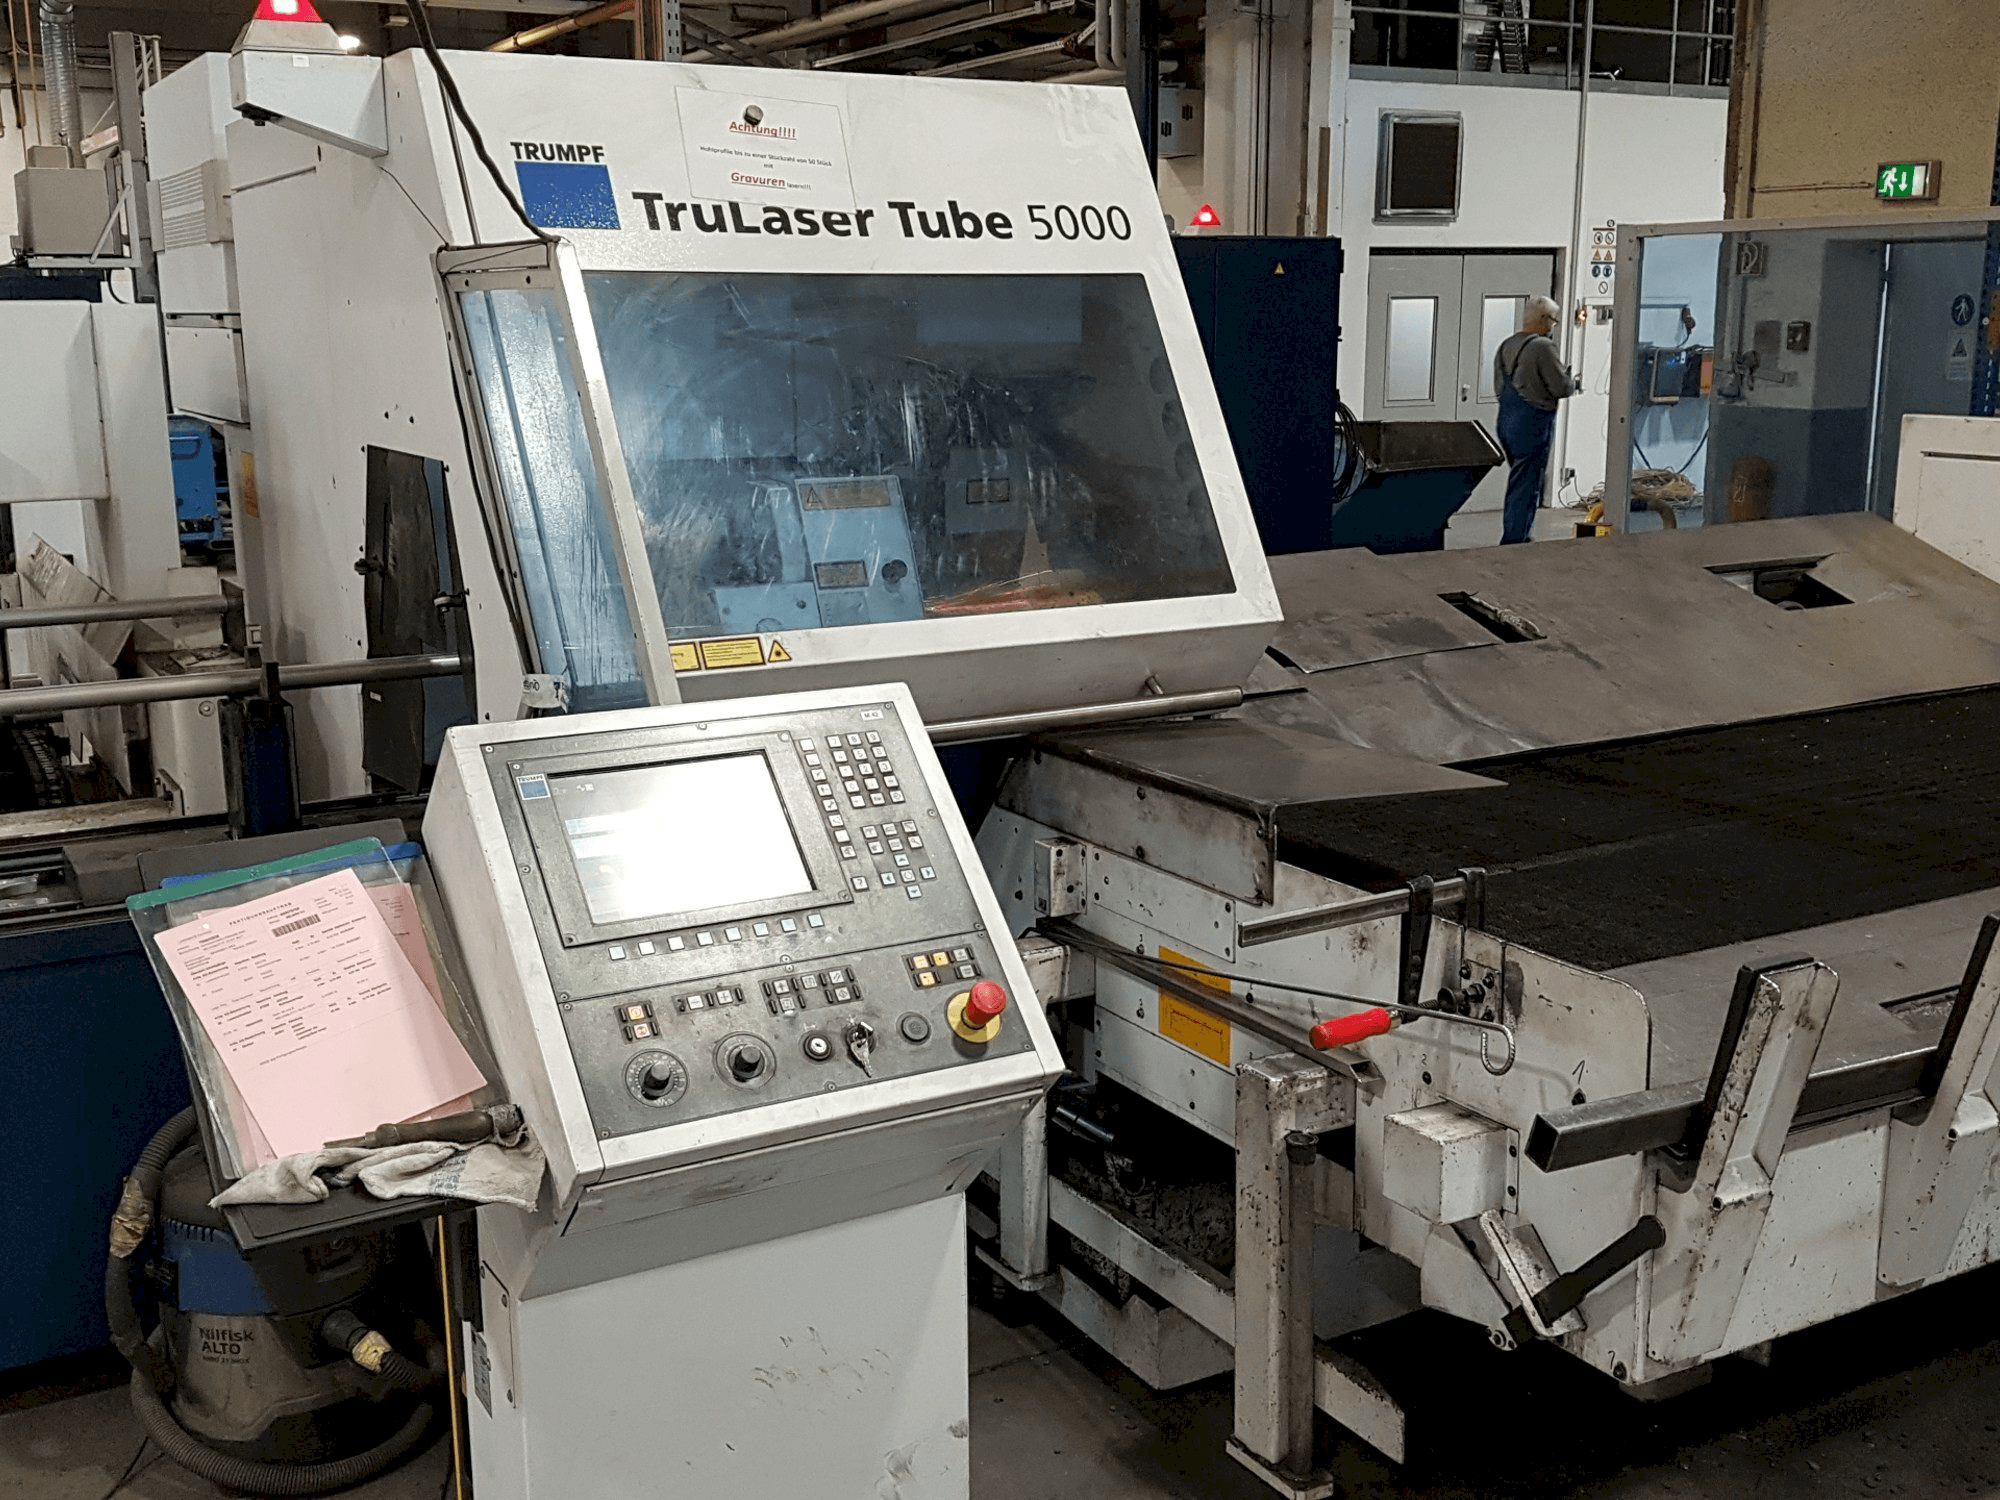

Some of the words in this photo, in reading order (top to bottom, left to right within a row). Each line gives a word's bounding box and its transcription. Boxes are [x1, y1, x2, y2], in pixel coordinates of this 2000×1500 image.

[729, 121, 796, 138] Achtung!!!!
[510, 141, 605, 163] TRUMPF
[731, 172, 786, 188] Gravuren
[632, 191, 874, 238] TruLaser
[887, 200, 1013, 240] Tube
[1026, 204, 1132, 241] 5000
[198, 1327, 255, 1342] Nilfisk
[201, 1341, 241, 1355] ALTO
